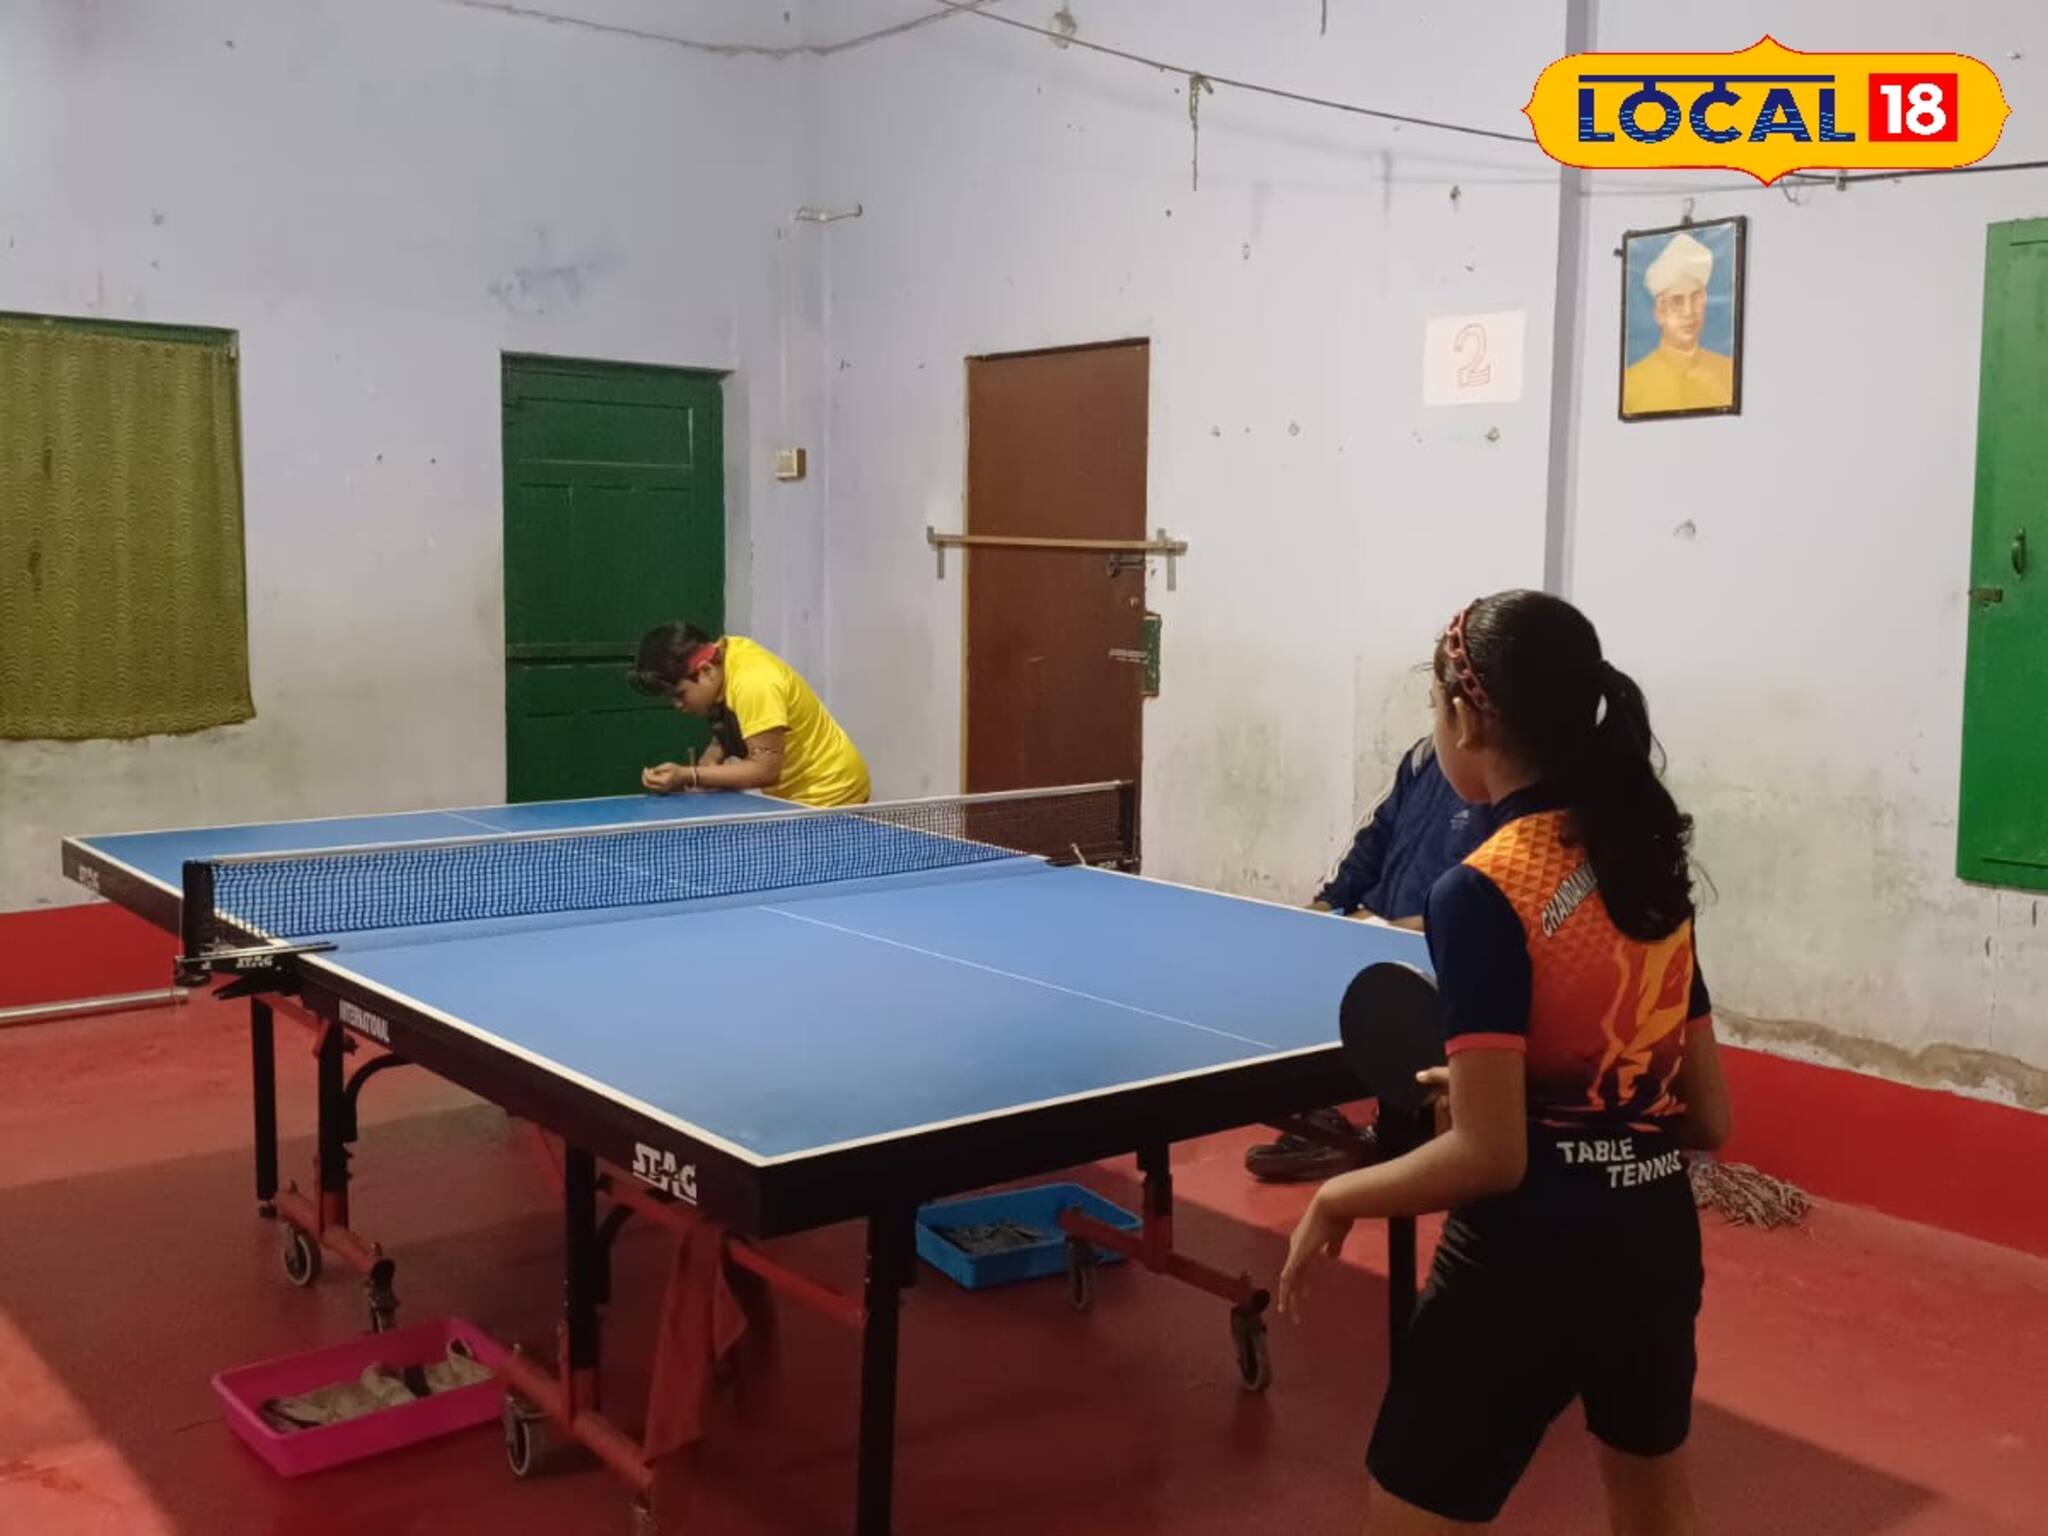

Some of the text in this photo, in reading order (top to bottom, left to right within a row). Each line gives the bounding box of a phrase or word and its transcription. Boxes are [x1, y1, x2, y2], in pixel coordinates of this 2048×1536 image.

[1454, 322, 1491, 388] 2
[632, 1141, 698, 1206] STAG
[1556, 1138, 1636, 1164] TABLE
[1606, 1149, 1682, 1189] TENNIS
